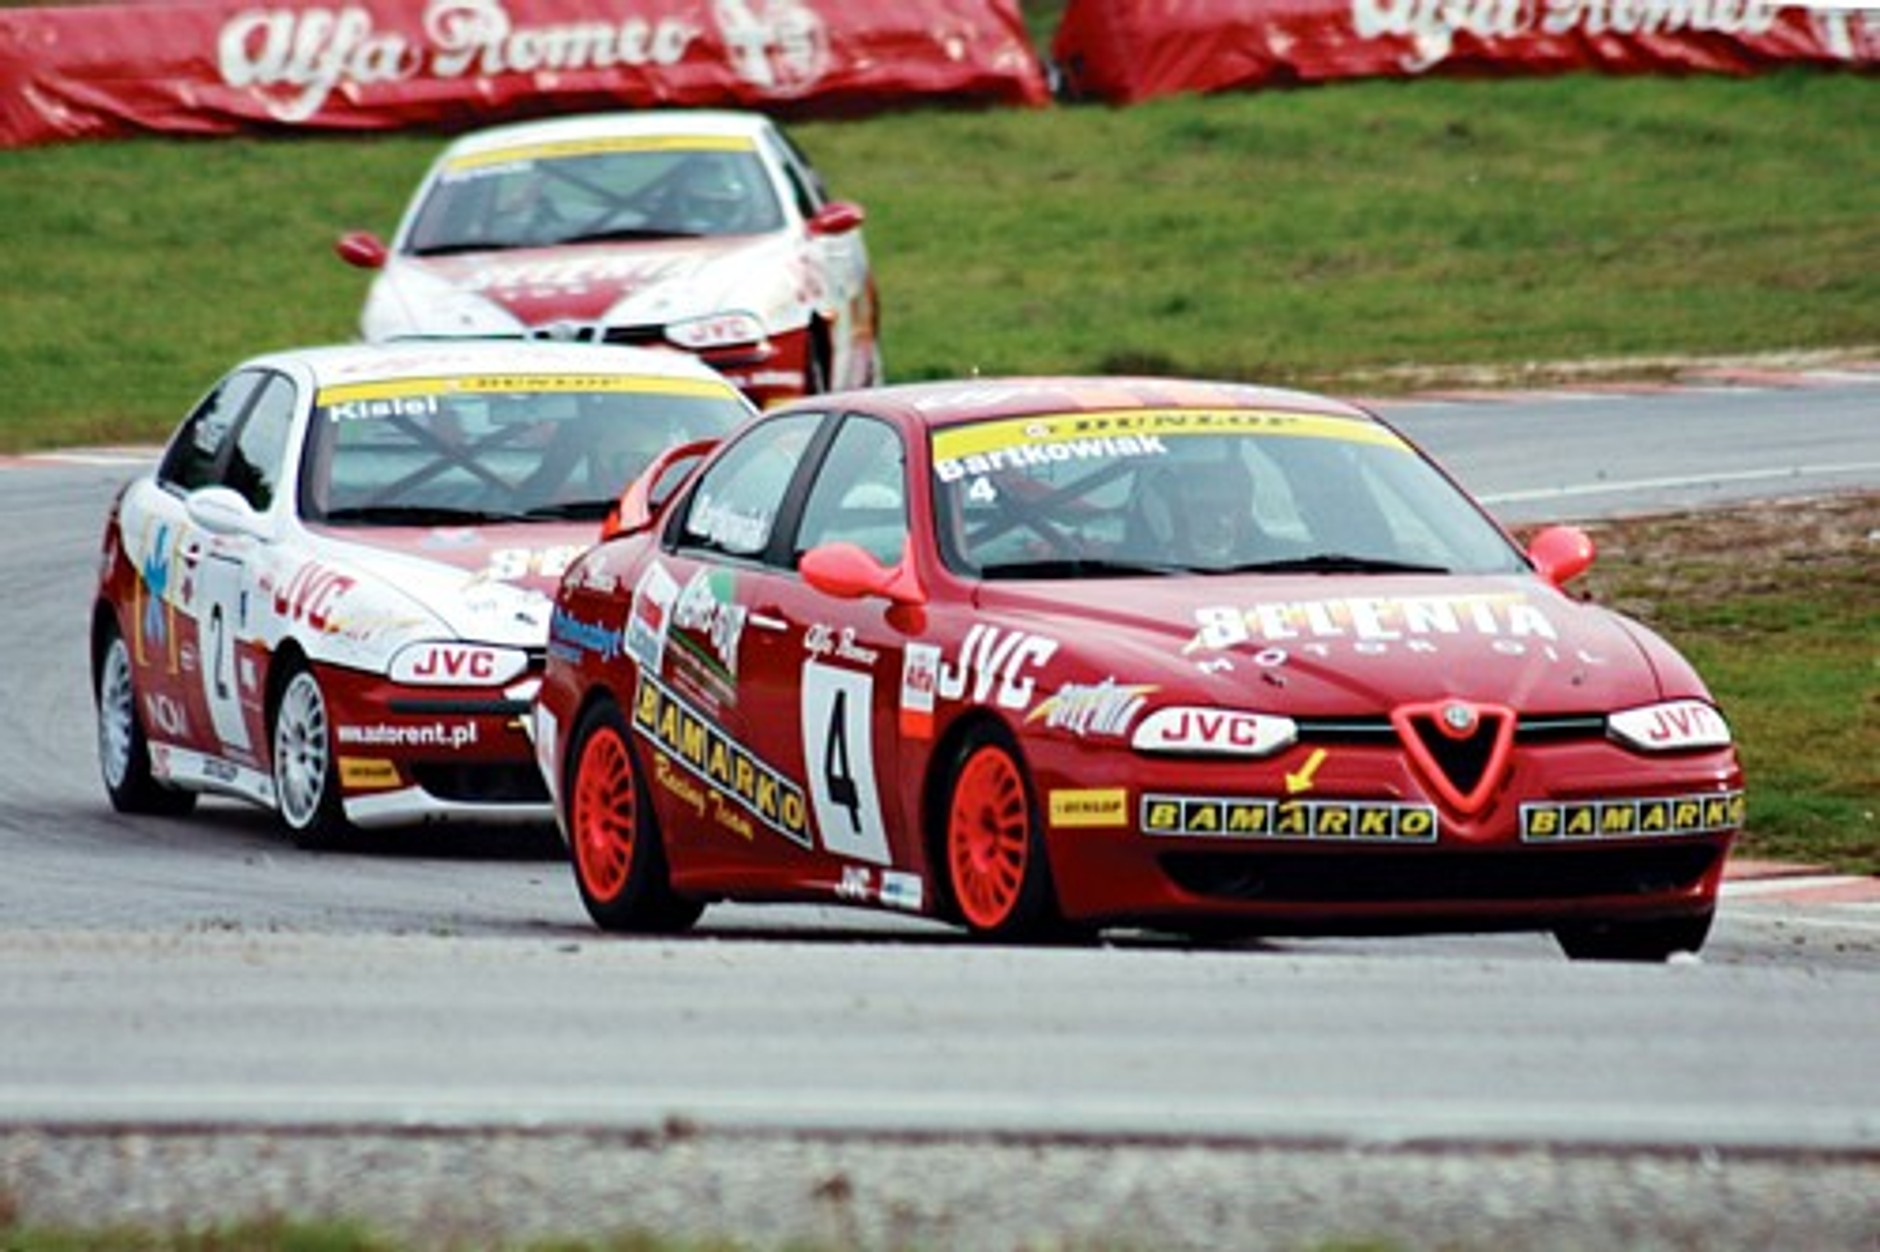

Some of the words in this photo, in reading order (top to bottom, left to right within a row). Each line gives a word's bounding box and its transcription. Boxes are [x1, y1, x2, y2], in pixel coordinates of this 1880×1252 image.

[218, 7, 421, 122] Alfa
[421, 0, 703, 78] Romeo
[329, 395, 438, 422] Kisiel
[934, 433, 1168, 483] Bartkowiak
[969, 476, 997, 503] 4
[210, 602, 229, 700] 2
[413, 649, 496, 678] JVC
[937, 624, 1059, 710] JVC
[1198, 637, 1438, 675] MOTOR
[1492, 638, 1605, 665] OIL
[1161, 713, 1258, 747] JVC
[637, 684, 807, 831] BAMARKO
[824, 688, 863, 835] 4
[1149, 801, 1432, 835] BAMARKO
